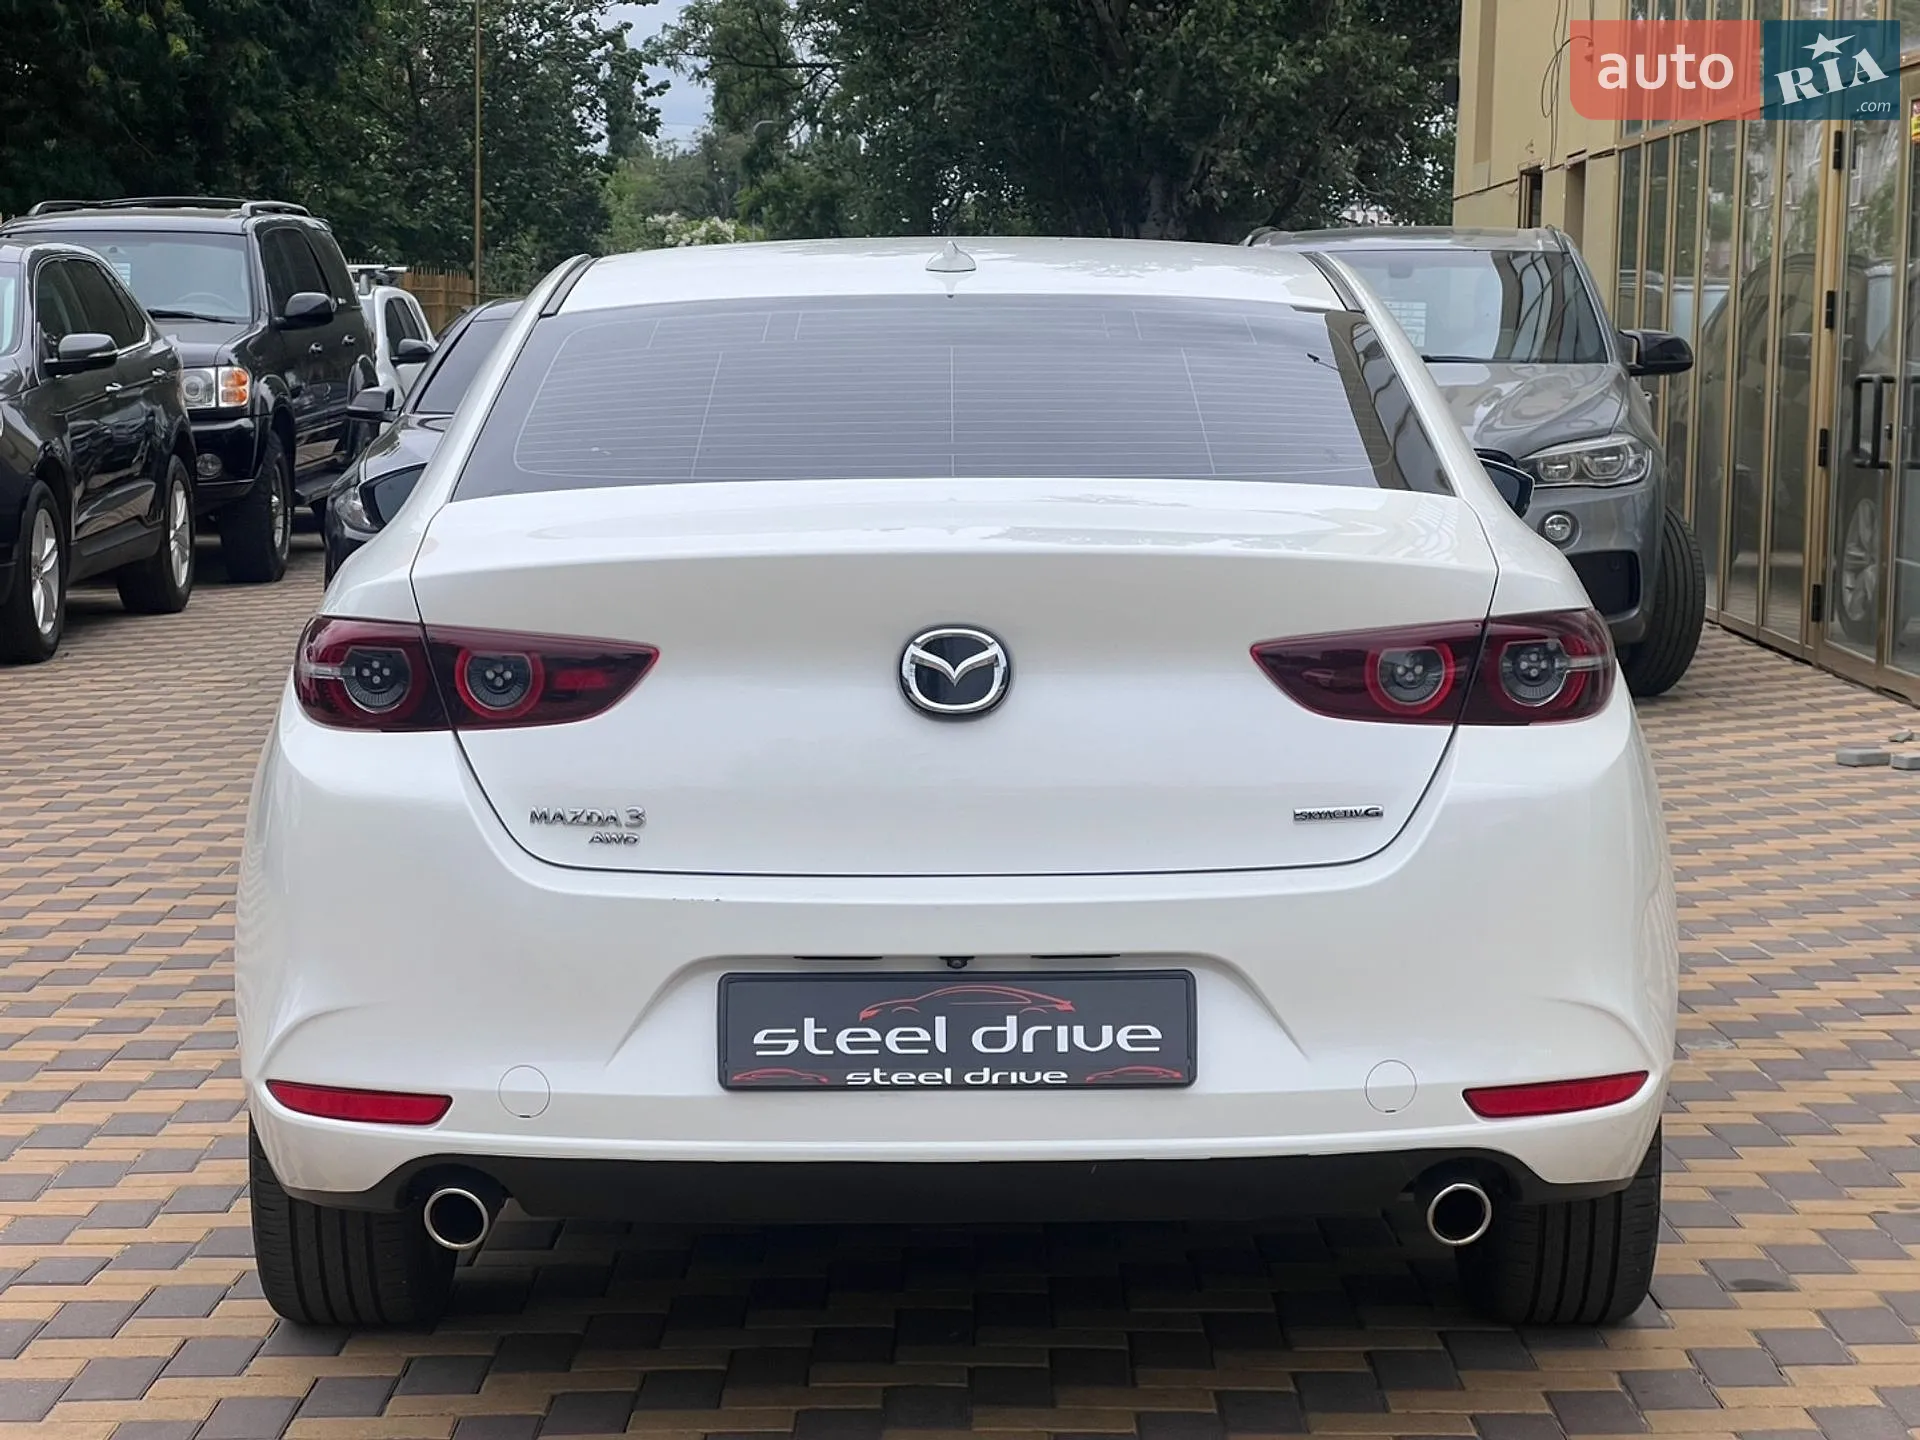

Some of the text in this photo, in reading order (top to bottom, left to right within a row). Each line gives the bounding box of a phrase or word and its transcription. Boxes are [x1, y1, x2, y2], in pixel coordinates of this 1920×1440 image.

[529, 806, 647, 828] MAZDA 3
[588, 831, 641, 846] AWD
[753, 1016, 1163, 1056] steel drive
[846, 1067, 1068, 1085] steel drive
